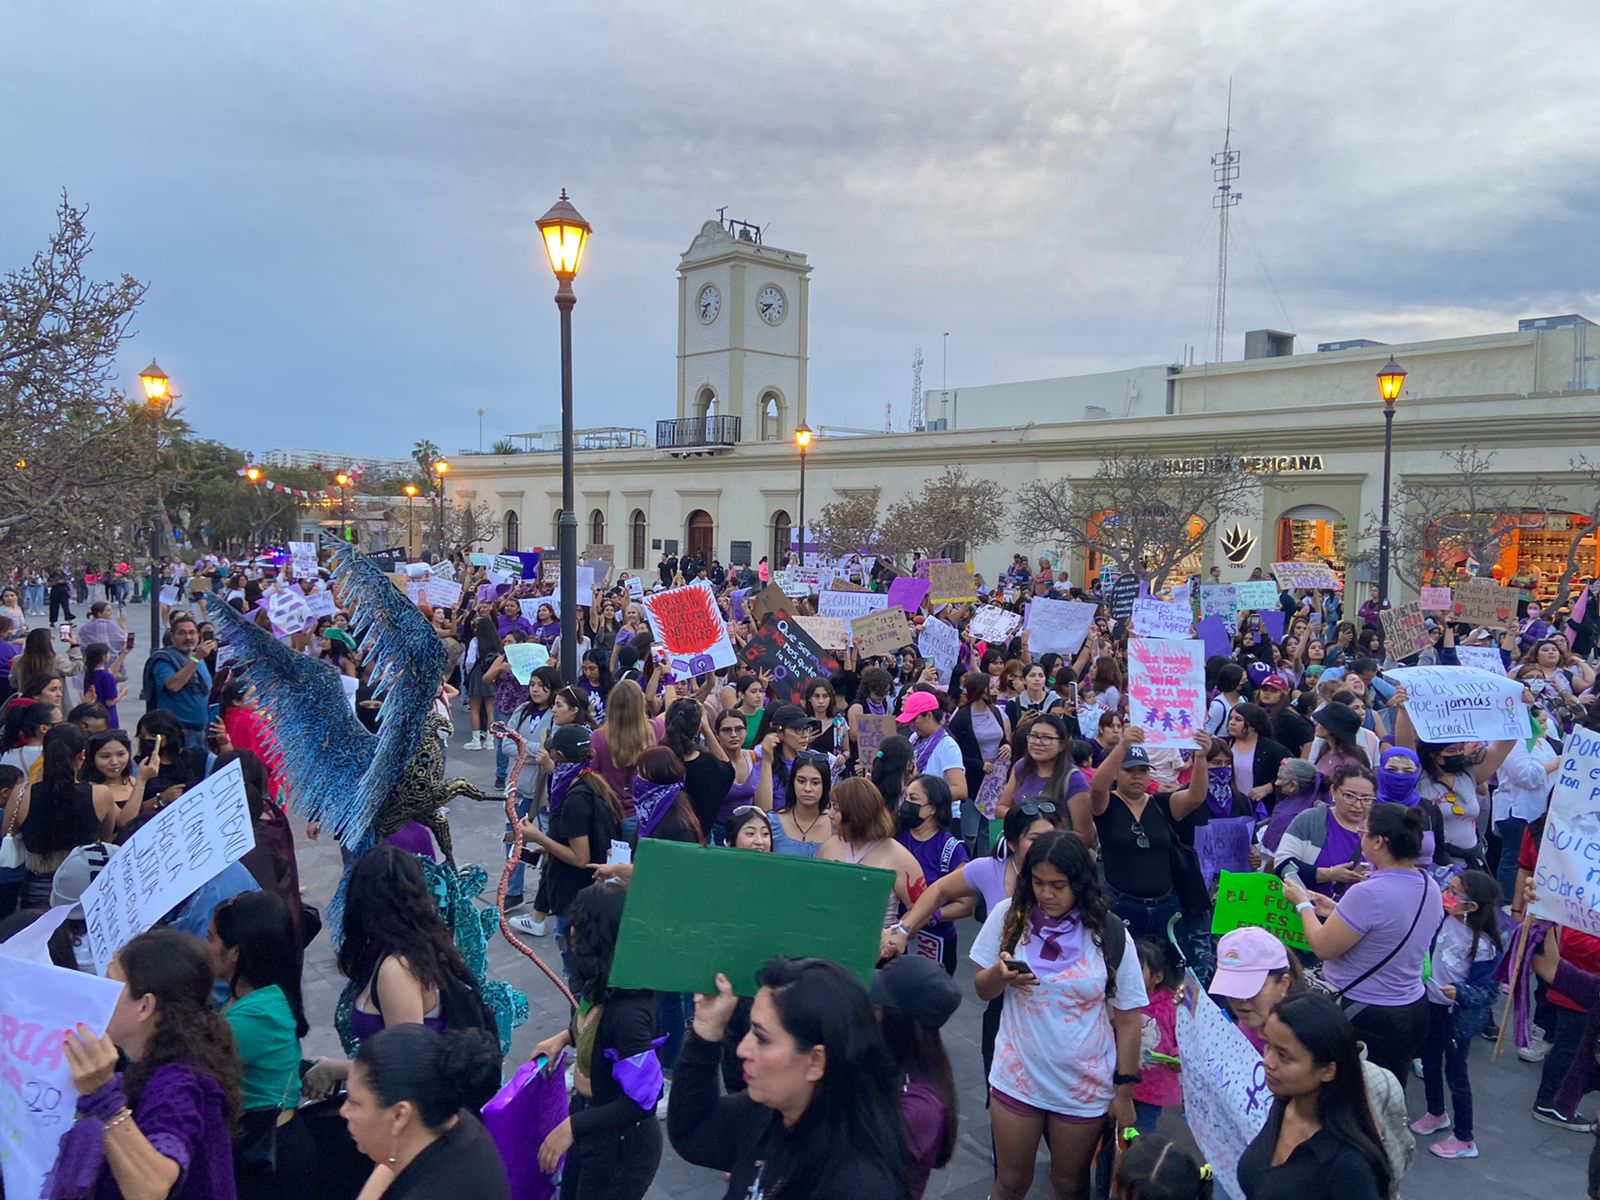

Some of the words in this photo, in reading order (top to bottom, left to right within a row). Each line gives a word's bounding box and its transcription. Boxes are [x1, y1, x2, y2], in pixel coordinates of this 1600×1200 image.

[1239, 454, 1324, 472] MEXICANA
[777, 620, 798, 643] Que
[797, 641, 812, 657] ser
[783, 642, 800, 660] nos
[797, 658, 817, 678] quite
[784, 658, 800, 678] vida
[1407, 680, 1422, 697] de
[1426, 679, 1452, 696] las
[1410, 701, 1435, 720] que
[1564, 759, 1577, 771] a
[1227, 890, 1248, 902] EL
[1266, 912, 1289, 926] ES
